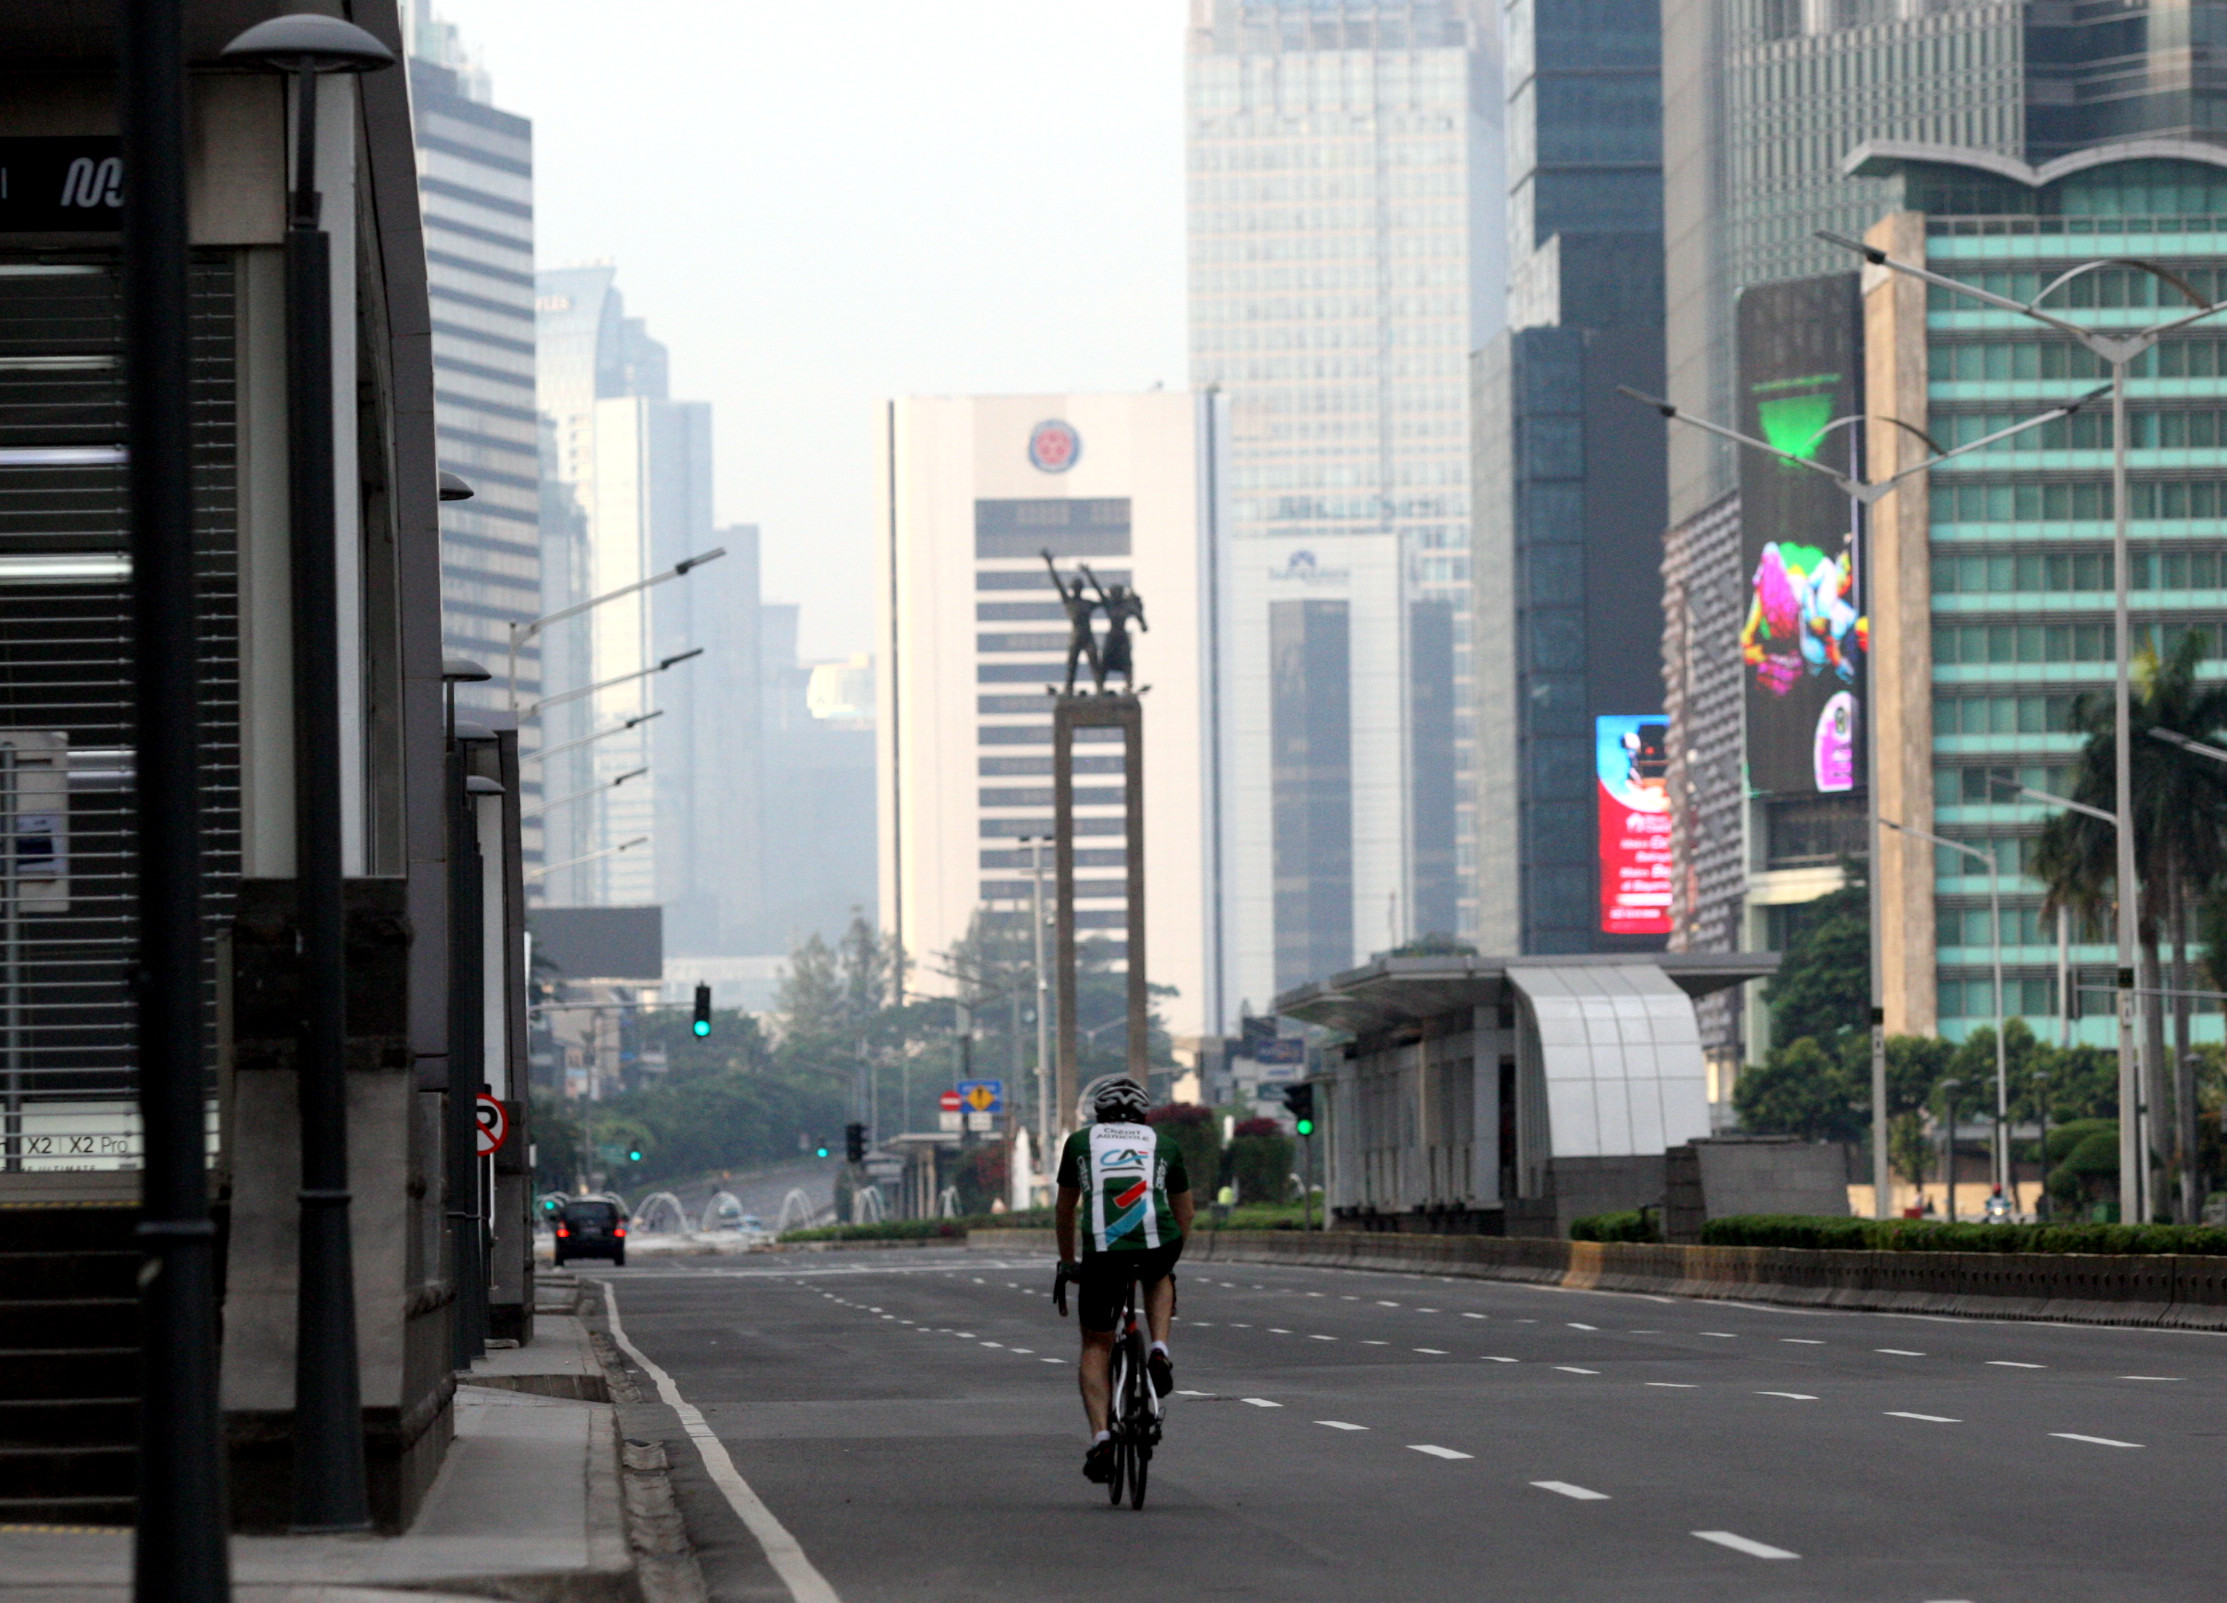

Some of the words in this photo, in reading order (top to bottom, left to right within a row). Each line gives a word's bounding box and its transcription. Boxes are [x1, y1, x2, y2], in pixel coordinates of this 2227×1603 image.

[27, 1137, 52, 1154] X2
[70, 1136, 94, 1153] X2
[101, 1136, 128, 1153] Pro
